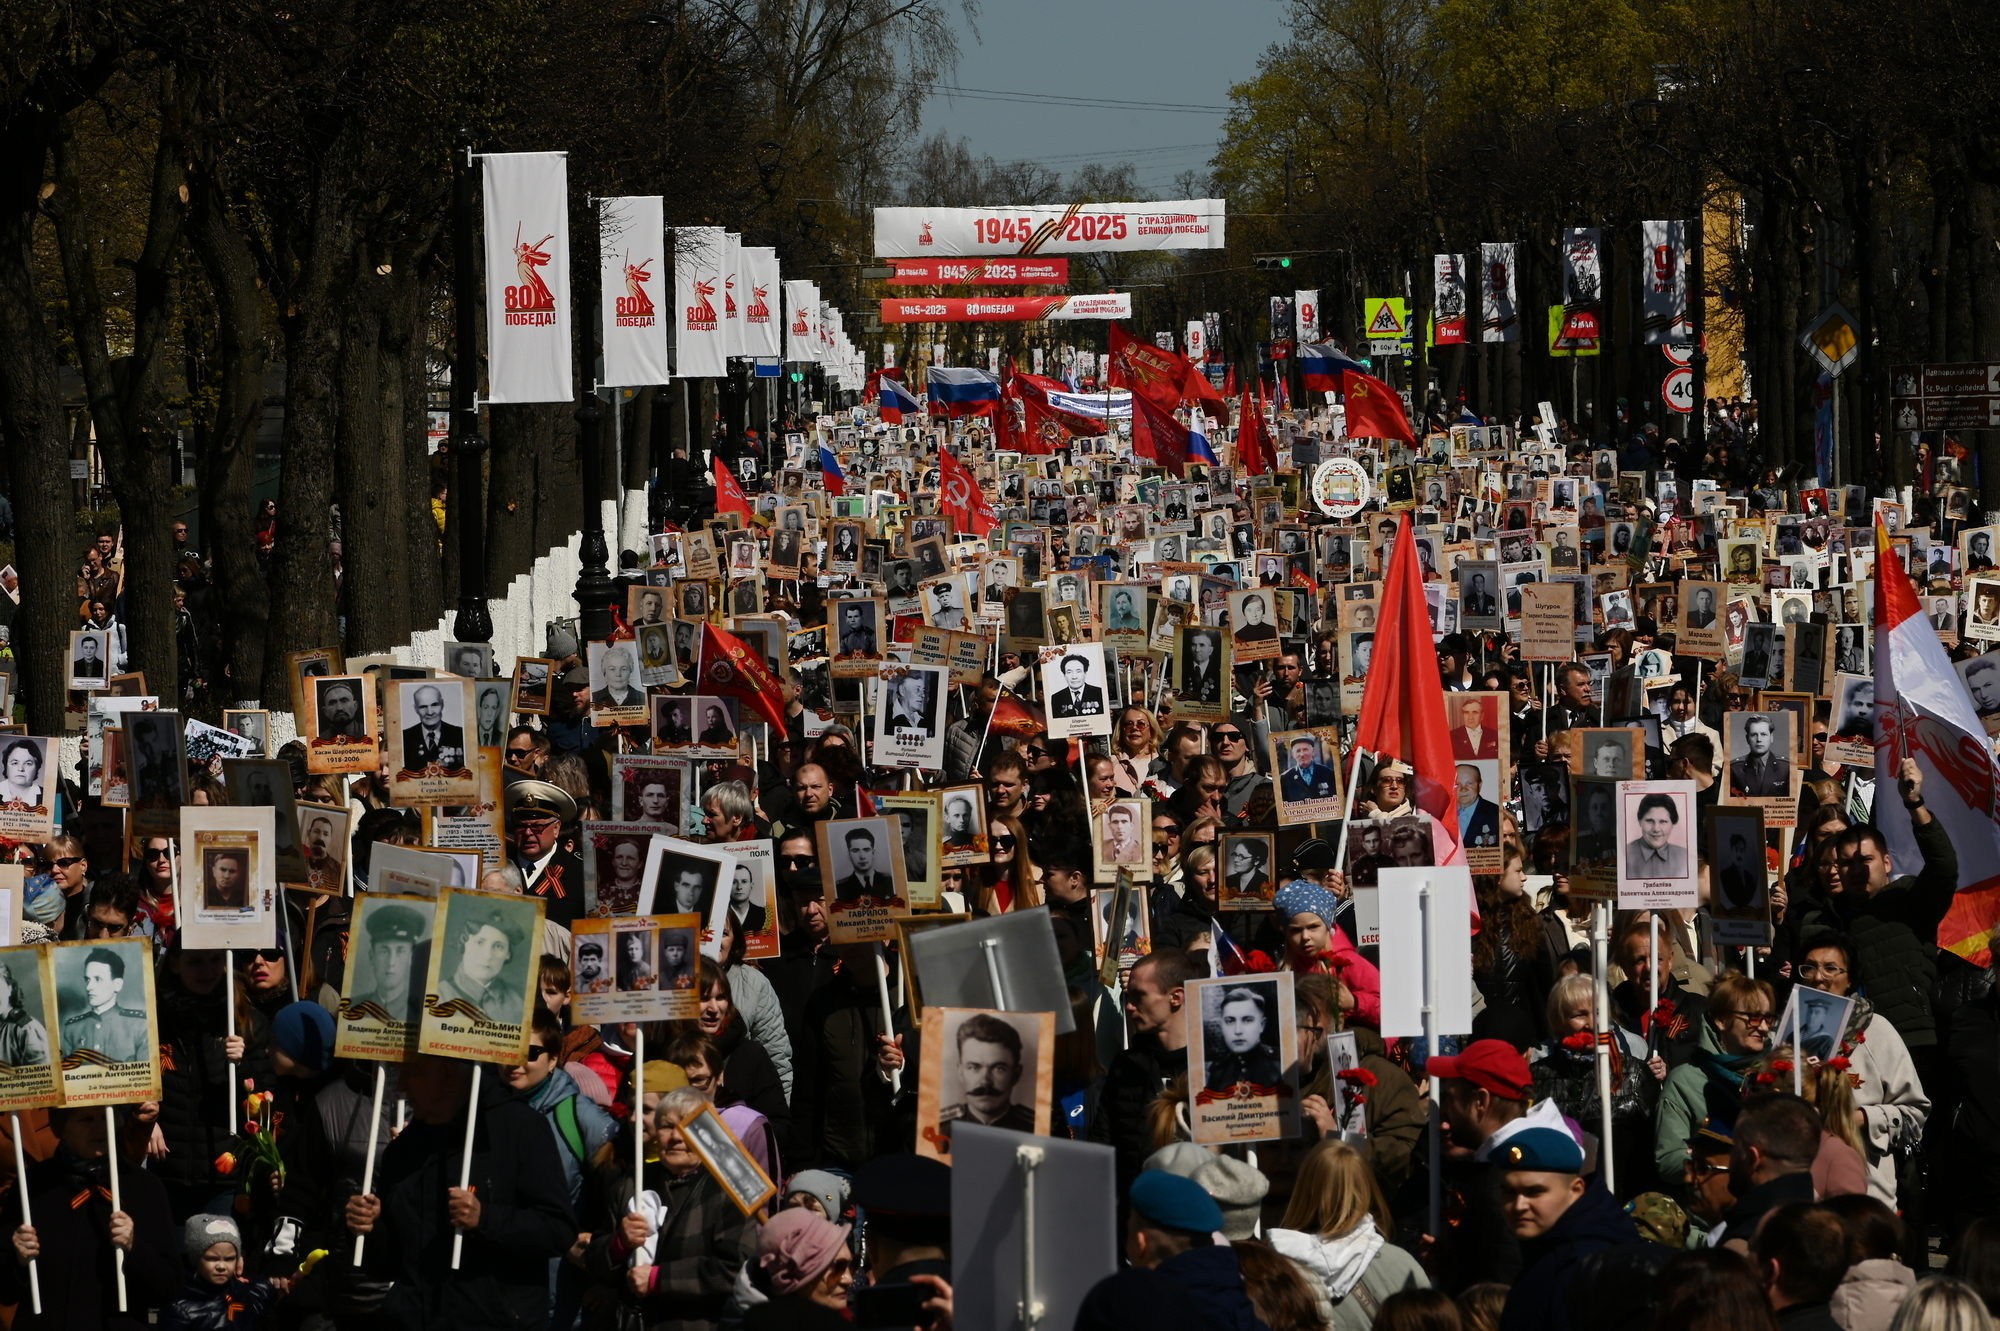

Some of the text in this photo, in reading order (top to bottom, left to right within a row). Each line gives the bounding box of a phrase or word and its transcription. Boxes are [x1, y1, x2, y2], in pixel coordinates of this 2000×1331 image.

[1145, 215, 1197, 225] ПРАЗДНИКОМ
[974, 218, 1033, 244] 1945
[1067, 215, 1127, 242] 2025
[1138, 224, 1209, 235] ВЕЛИКОЙ ПОБЕДЫ!
[1654, 245, 1674, 280] 9
[938, 265, 968, 279] 1945
[984, 265, 1016, 279] 2025
[1491, 262, 1506, 290] 9
[1654, 283, 1675, 293] МАЯ
[505, 285, 532, 309] 80
[616, 297, 638, 315] 80
[981, 305, 1014, 315] ПОБЕДА!
[687, 307, 705, 321] 80
[1301, 303, 1313, 323] 9
[505, 313, 556, 327] ПОБЕДА!
[616, 317, 655, 328] ПОБЕДА!
[687, 323, 718, 332] ПОБЕДА!
[1955, 383, 1985, 392] Cathedral
[333, 748, 371, 756] Шарофиддин
[616, 758, 667, 766] БЕССМЕРТНЫЙ
[1303, 796, 1338, 806] Николай
[1282, 804, 1339, 816] Александрович
[586, 824, 661, 833] БЕССМЕРТНЫЙ ПОЛК
[750, 850, 770, 858] ПОЛК
[1652, 890, 1694, 898] Александровна
[848, 909, 889, 917] ГАВРИЛОВ
[837, 919, 866, 928] Михаил
[347, 1025, 381, 1035] Владимир
[473, 1020, 521, 1033] КУЗЬМИЧ
[441, 1023, 521, 1041] Вера Антоновна
[342, 1045, 397, 1056] БЕССМЕРТНЫЙ
[429, 1042, 493, 1058] БЕССМЕРТНЫЙ
[495, 1051, 519, 1060] ПОЛК
[15, 1065, 51, 1073] КУЗЬМИЧ
[108, 1062, 151, 1071] КУЗЬМИЧ
[64, 1069, 151, 1081] Василий Антонович
[98, 1083, 132, 1091] Украинский
[133, 1081, 151, 1089] фронт
[33, 1094, 57, 1103] ПОЛК
[129, 1089, 153, 1098] ПОЛК
[1202, 1110, 1289, 1122] Василий Дмитриевич
[1225, 1121, 1265, 1130] Артиллерист
